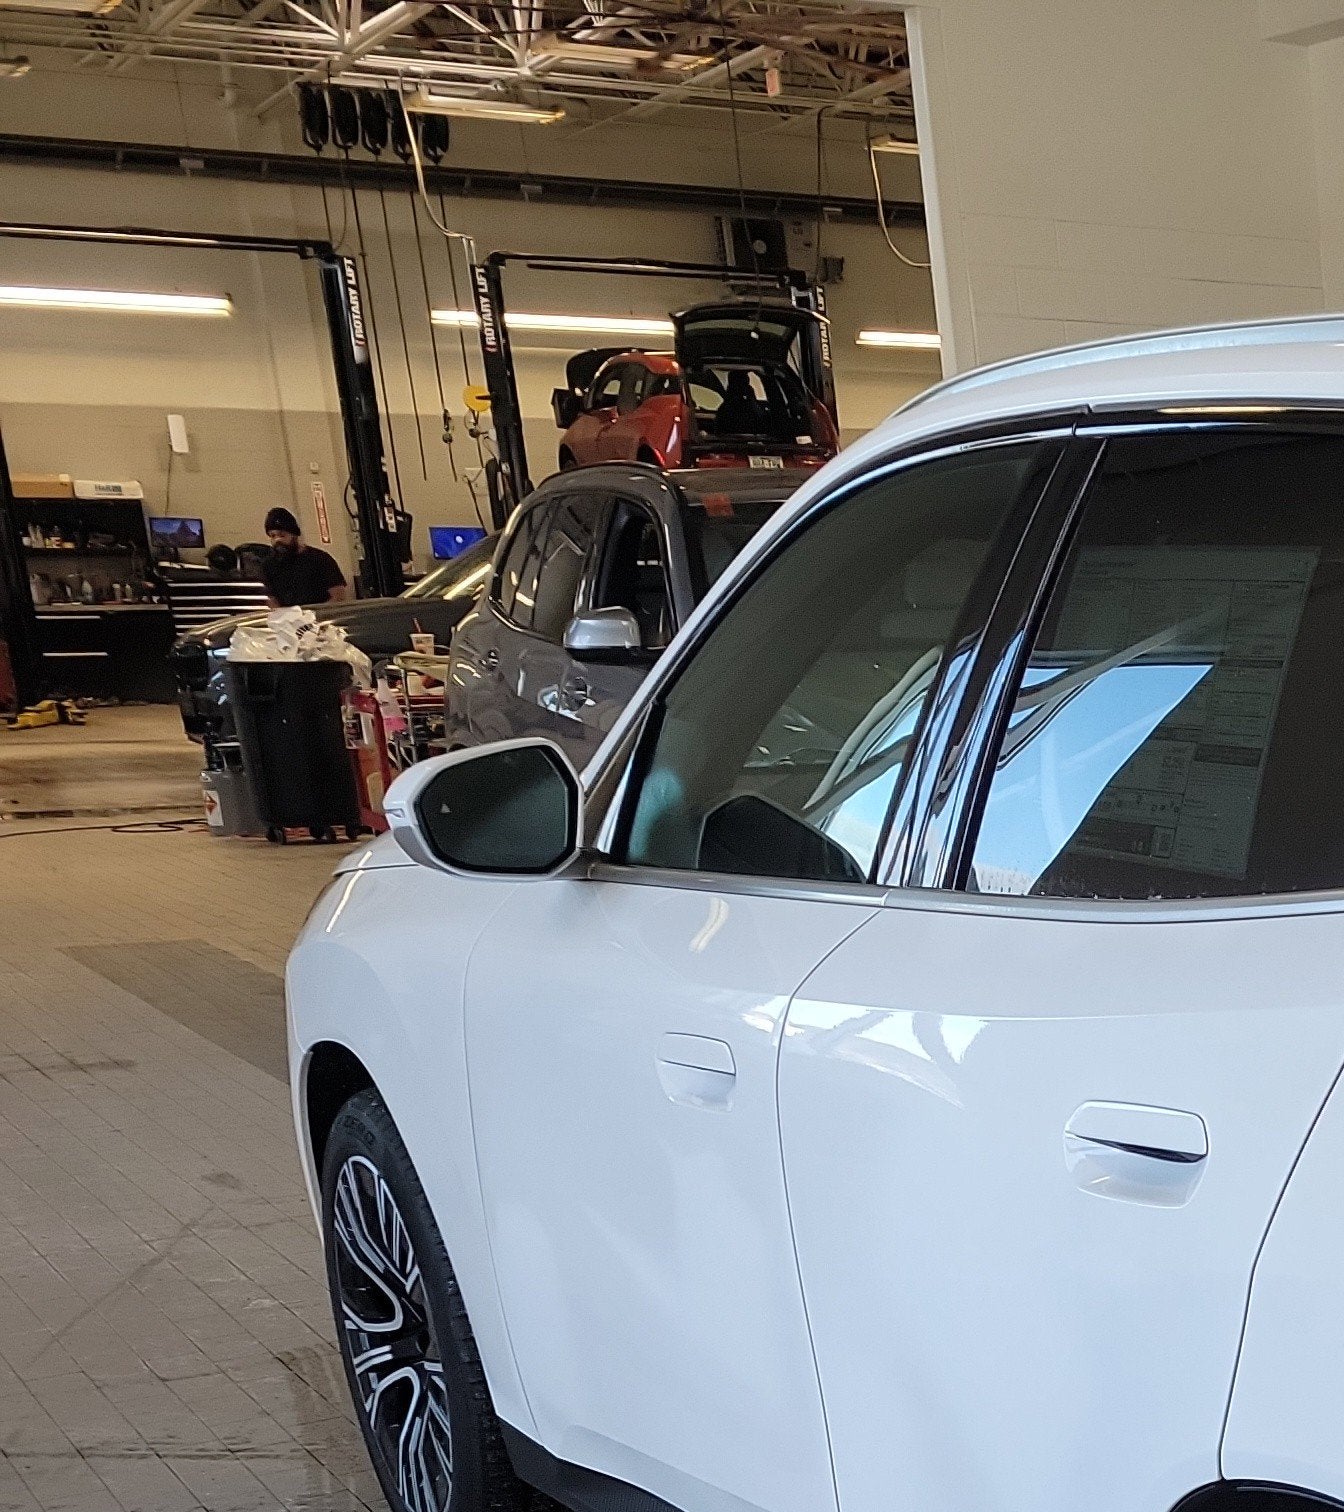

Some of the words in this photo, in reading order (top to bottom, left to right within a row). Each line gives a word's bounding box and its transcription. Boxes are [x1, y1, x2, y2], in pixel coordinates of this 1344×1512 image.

[344, 258, 357, 285] LIFT
[475, 267, 488, 293] LIFT
[349, 287, 365, 340] ROTARY
[480, 297, 497, 347] ROTARY
